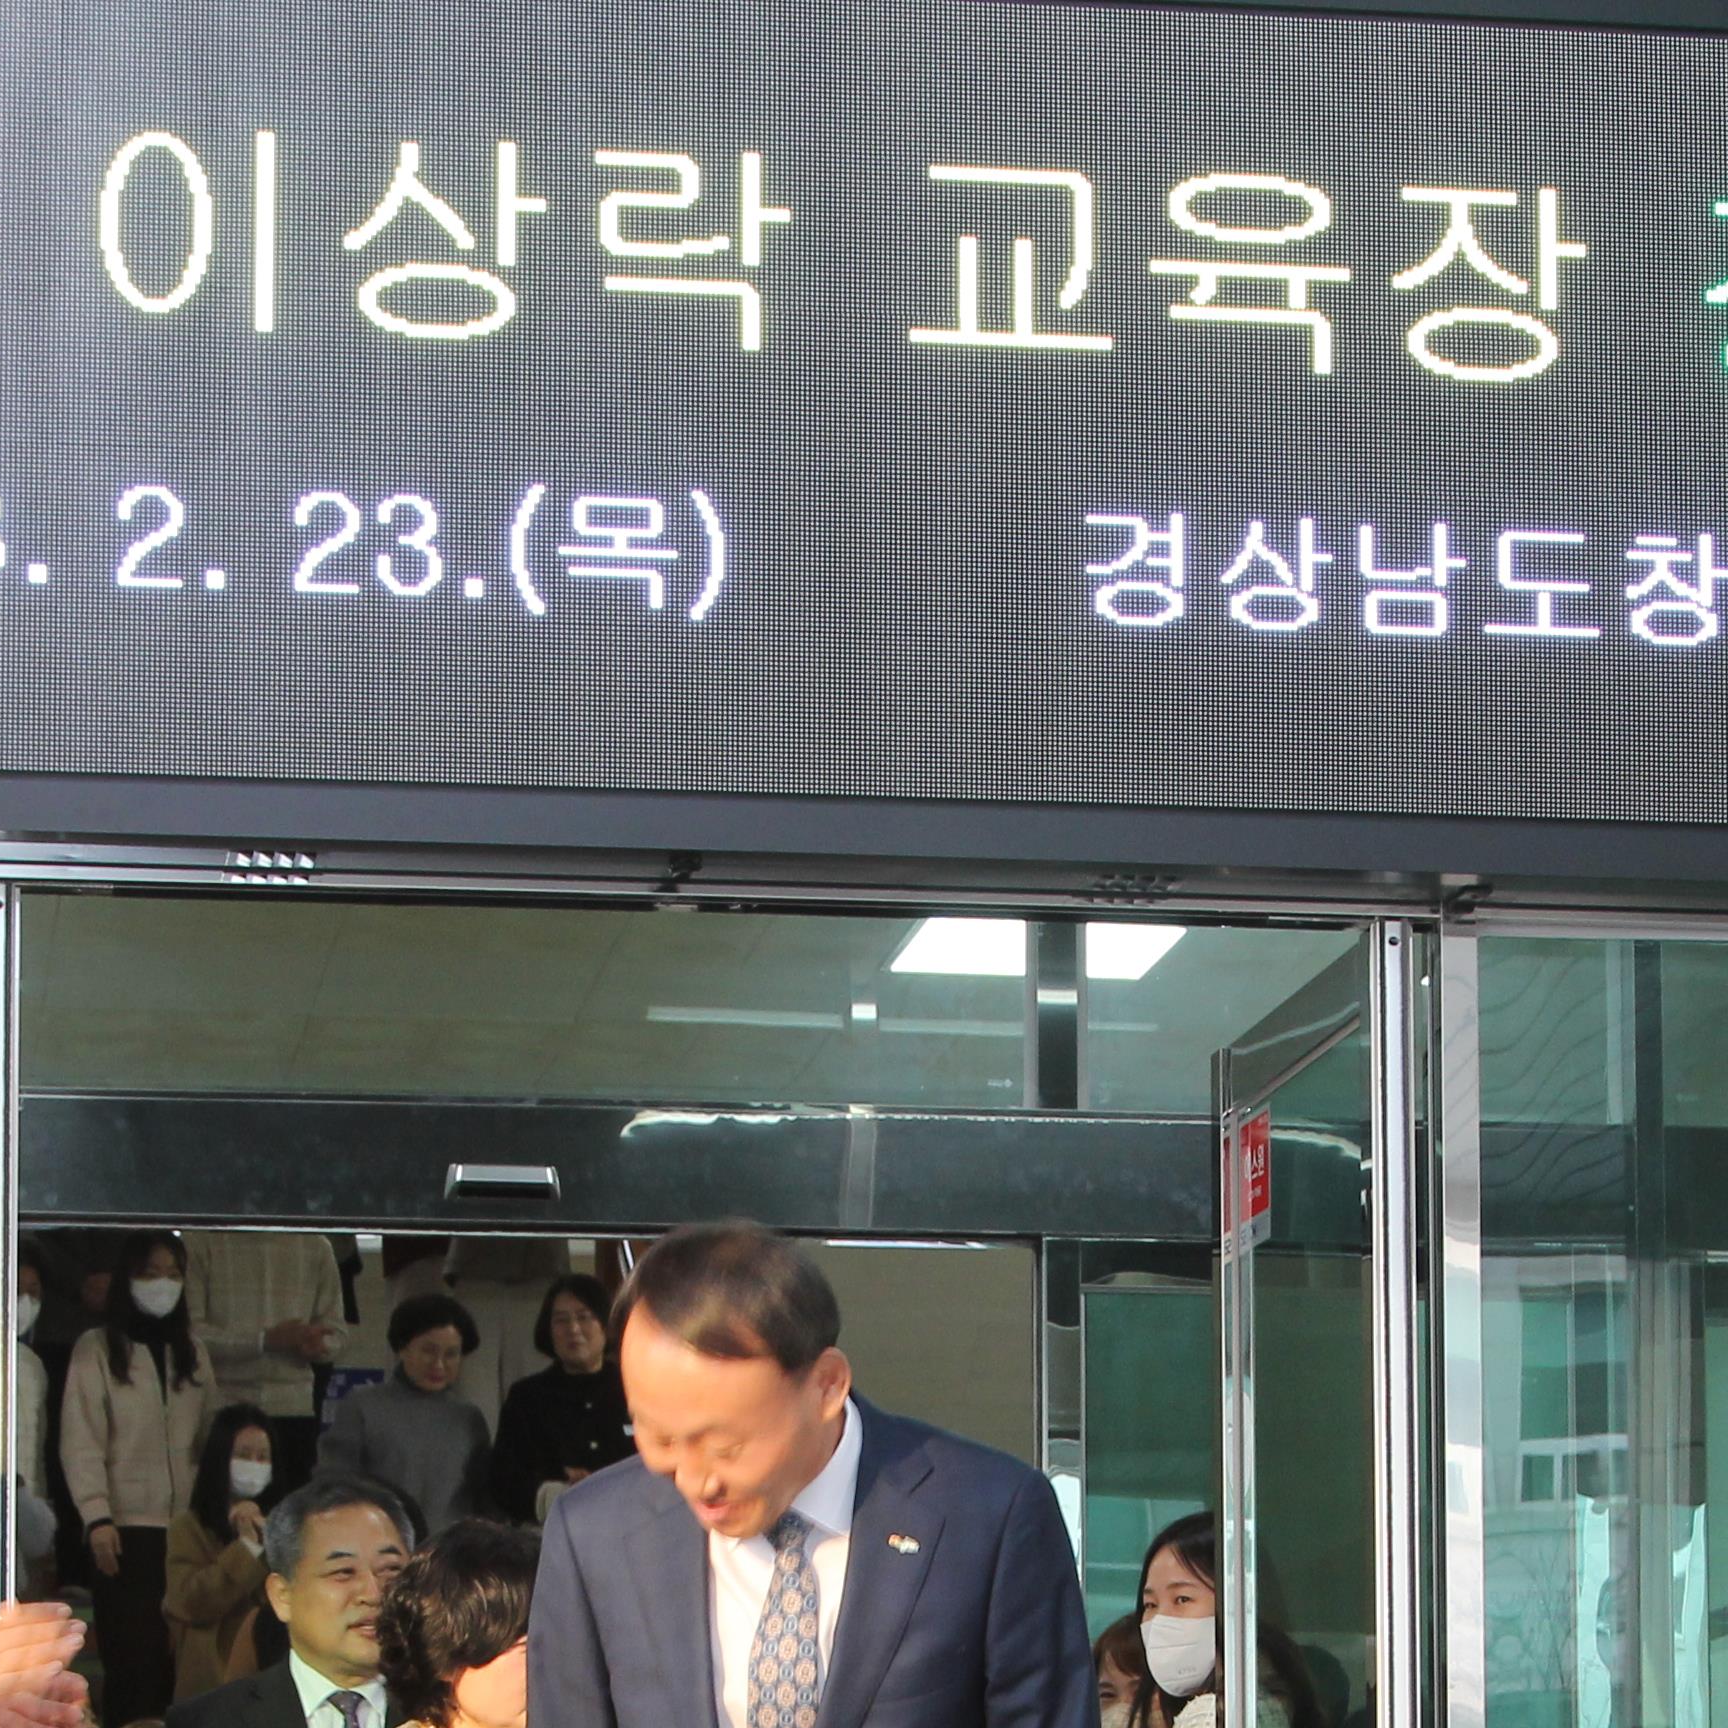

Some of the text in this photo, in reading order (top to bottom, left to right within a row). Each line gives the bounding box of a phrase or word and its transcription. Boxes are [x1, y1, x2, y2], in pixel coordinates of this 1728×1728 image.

[97, 129, 790, 351] 이상락
[909, 165, 1585, 382] 교육장
[113, 483, 227, 592] 2.
[291, 483, 727, 622] 23.(목)
